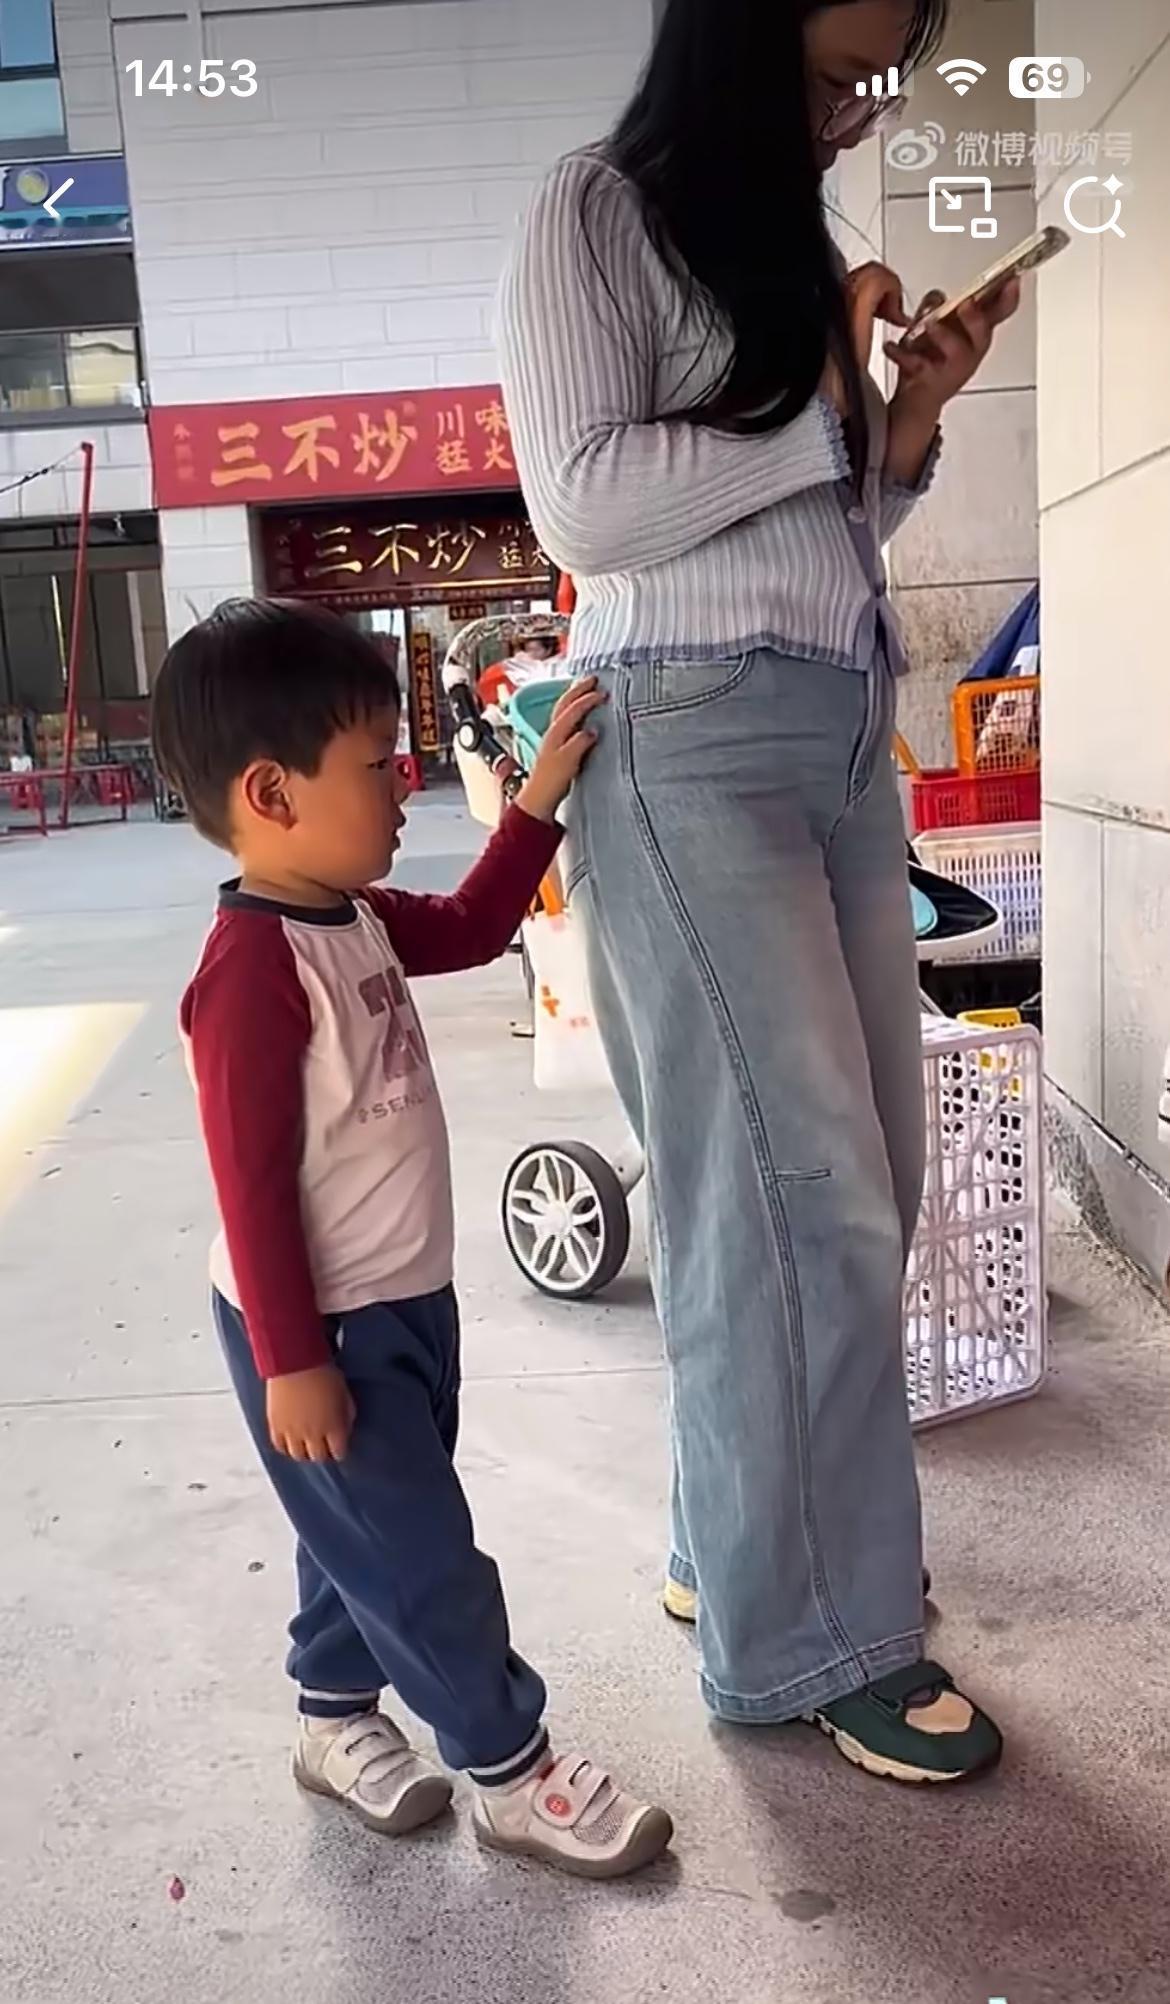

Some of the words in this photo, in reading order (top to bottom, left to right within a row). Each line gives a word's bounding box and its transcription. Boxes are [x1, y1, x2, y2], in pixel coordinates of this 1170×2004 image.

[437, 400, 508, 439] 川味
[210, 408, 418, 488] 三不炒
[436, 437, 513, 475] 猛火
[304, 522, 486, 577] 三不炒
